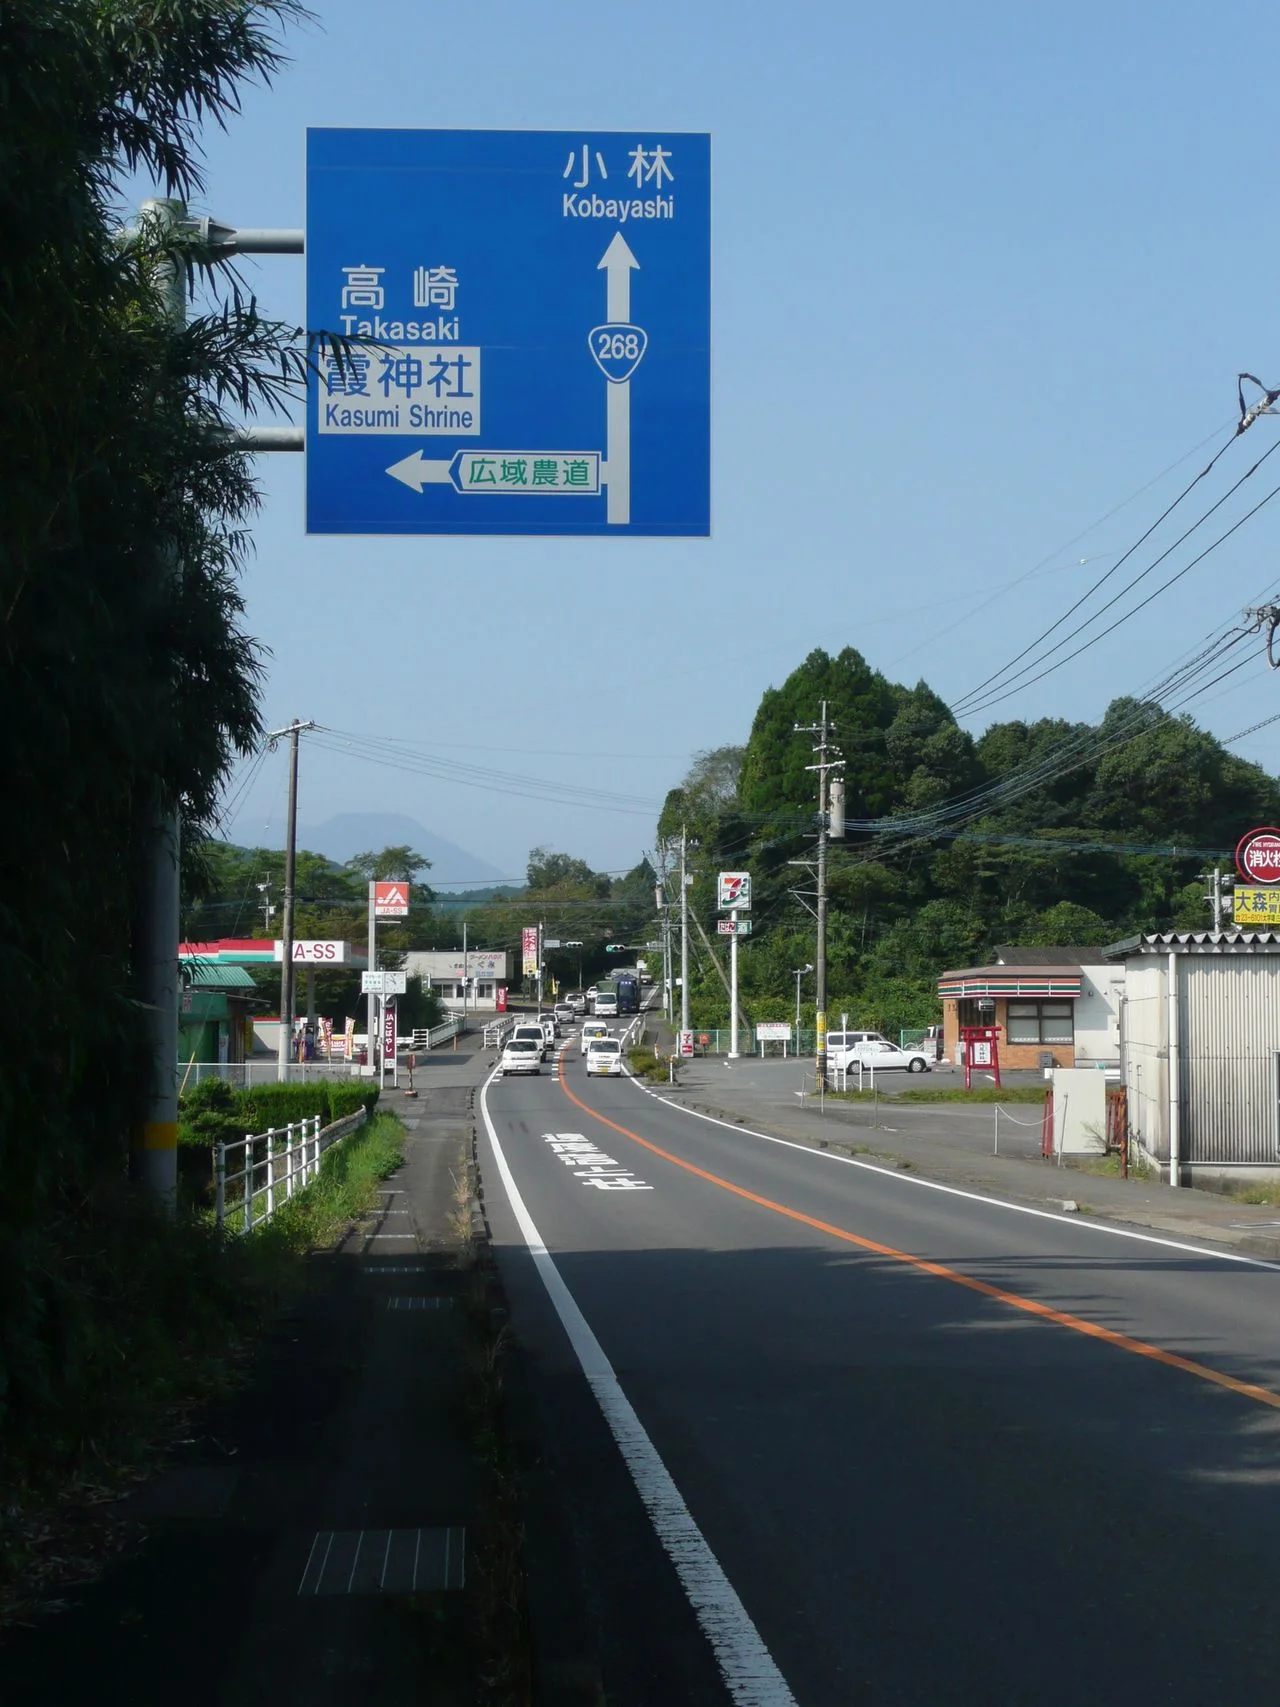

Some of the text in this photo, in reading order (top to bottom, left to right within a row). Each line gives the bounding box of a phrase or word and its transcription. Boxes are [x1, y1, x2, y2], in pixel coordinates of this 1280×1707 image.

[563, 144, 674, 189] 小林
[563, 195, 674, 222] Kobayashi
[341, 264, 459, 311] 高崎
[340, 315, 459, 341] Takasaki
[598, 334, 638, 360] 268
[325, 353, 474, 399] 霞神社
[326, 404, 473, 429] Kasumi Shrine
[469, 458, 590, 487] 広域農道
[1235, 891, 1268, 912] 大森
[294, 943, 335, 959] A-SS
[385, 1013, 394, 1053] JAこばやし
